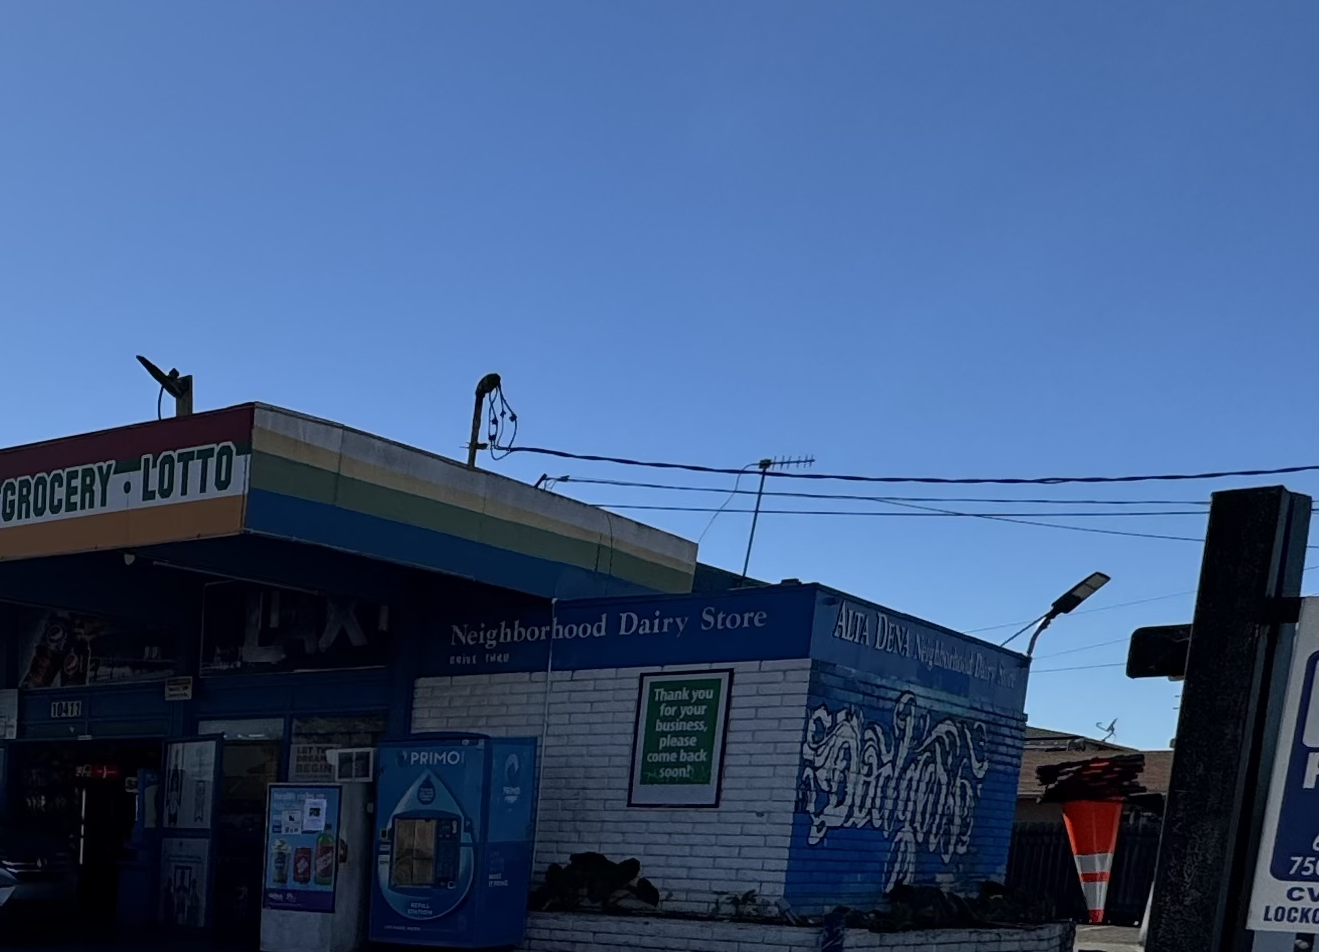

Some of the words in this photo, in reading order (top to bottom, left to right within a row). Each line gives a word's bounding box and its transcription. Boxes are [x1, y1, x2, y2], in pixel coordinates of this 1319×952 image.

[1, 462, 113, 522] GROCERY
[141, 445, 235, 501] LOTTO
[449, 613, 607, 649] Neighborhood
[618, 611, 689, 638] Dairy
[700, 606, 768, 632] Store
[832, 600, 870, 646] ALTA
[873, 612, 910, 658] DENA
[654, 687, 690, 701] Thank
[690, 688, 714, 703] you
[52, 702, 81, 718] 10411
[660, 703, 678, 717] for
[679, 704, 708, 719] your
[655, 718, 708, 732] business,
[658, 734, 698, 750] please
[410, 751, 460, 765] PRIMO
[646, 752, 677, 763] come
[678, 749, 709, 763] back
[658, 765, 692, 778] soon!
